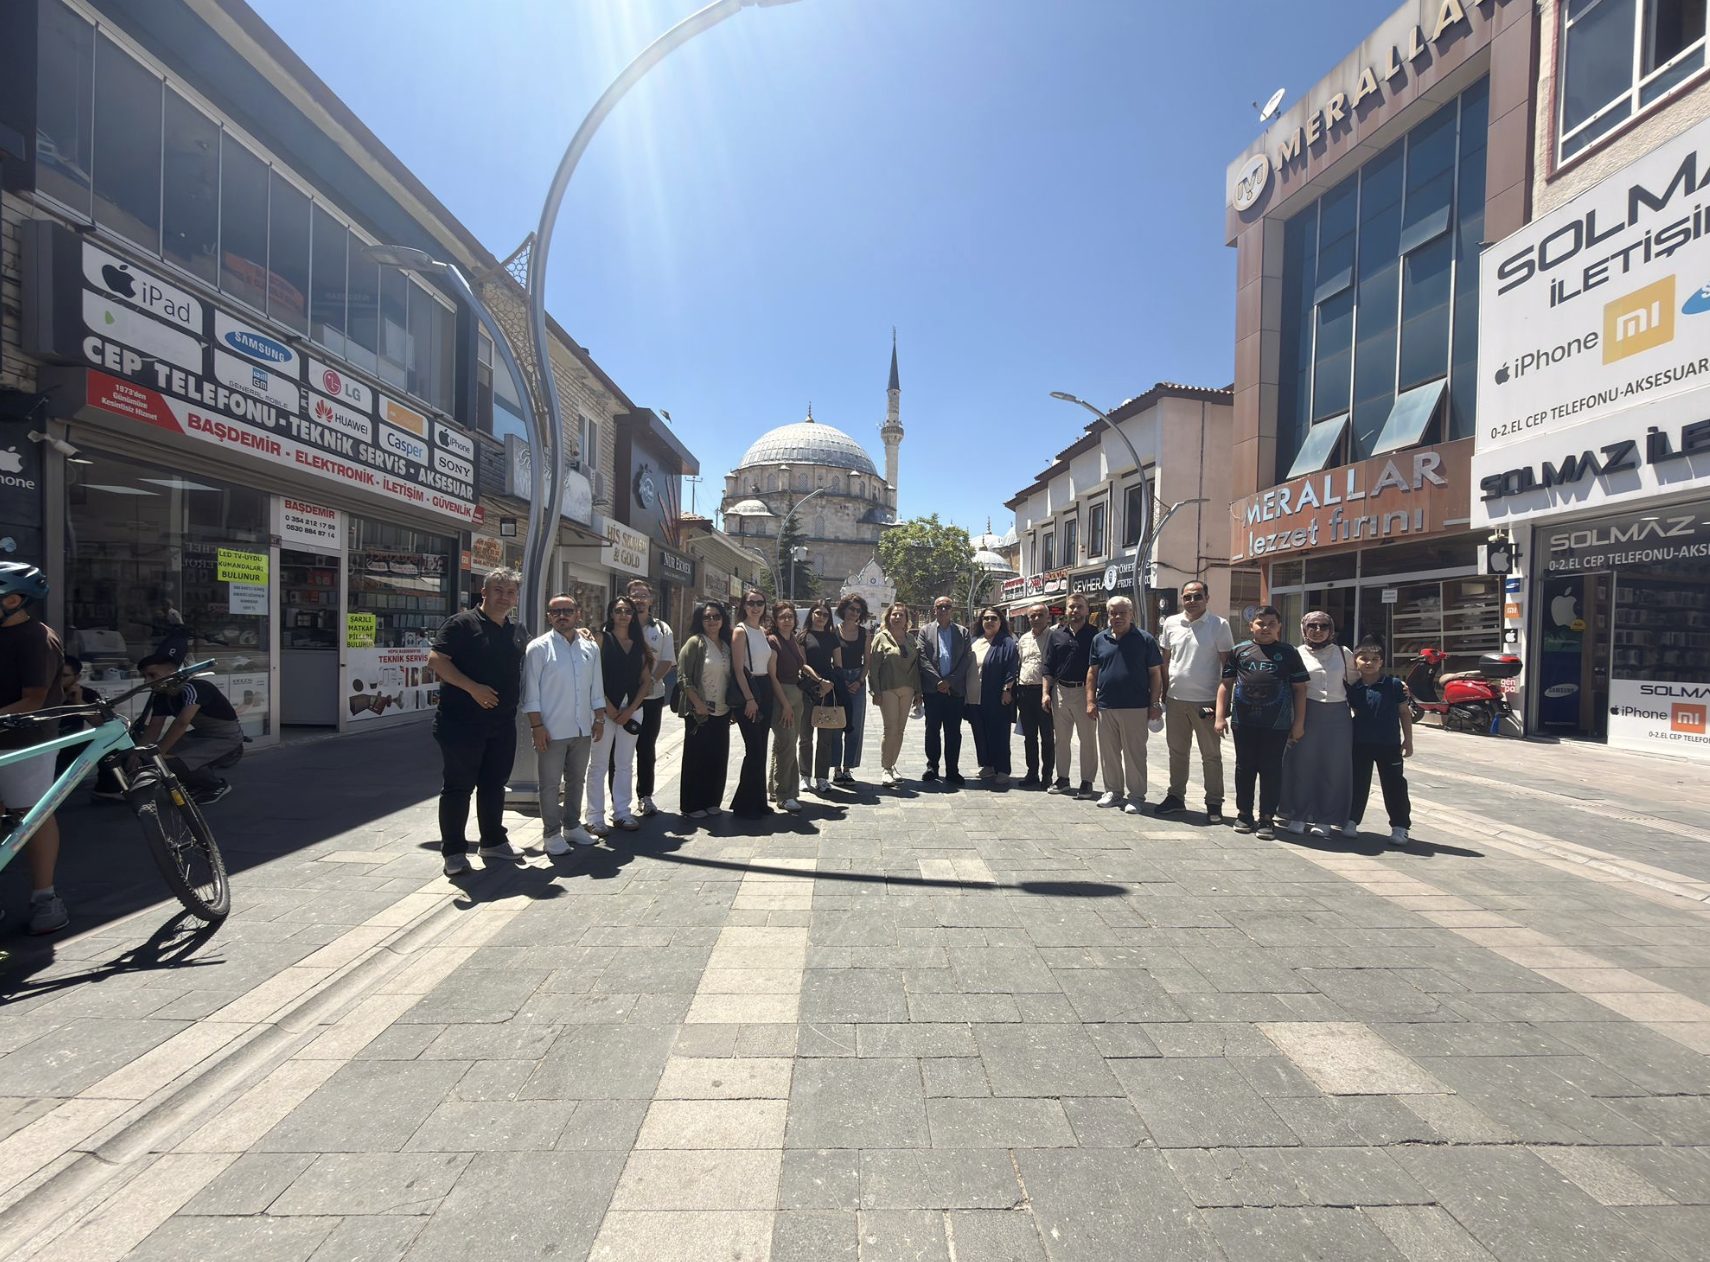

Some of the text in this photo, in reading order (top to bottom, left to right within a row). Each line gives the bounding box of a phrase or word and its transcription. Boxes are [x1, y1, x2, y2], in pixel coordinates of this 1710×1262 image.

[1277, 0, 1485, 173] MERALLA
[1497, 150, 1710, 297] SOLM
[1550, 203, 1710, 308] İLETİŞİ
[142, 282, 190, 324] iPad
[234, 331, 285, 363] SAMSUNG
[1514, 331, 1599, 379] iPhone
[229, 380, 264, 399] GENERAL
[345, 383, 361, 402] LG
[83, 336, 142, 375] CEP
[418, 467, 473, 500] AKSESUAR
[335, 413, 368, 436] HUAWEI
[1490, 420, 1523, 439] 0-2.EL
[1525, 411, 1547, 429] CEP
[387, 432, 423, 458] Casper
[449, 436, 471, 454] iPhone
[188, 412, 281, 457] BAŞDEMİR
[295, 449, 375, 486] ELEKTRONİK
[383, 475, 424, 503] İLETİŞİM
[432, 495, 471, 518] GÜVENLİK
[438, 456, 471, 477] SONY
[1481, 439, 1636, 502] SOLMAZ
[1244, 451, 1447, 527] MERALLAR
[284, 499, 335, 519] BAŞDEMİR
[305, 519, 317, 527] 212
[1249, 507, 1423, 557] lezzet fırını
[1550, 515, 1696, 551] SOLMAZ
[219, 550, 232, 558] LED
[621, 549, 640, 569] GOLD
[1549, 543, 1710, 571] 0-2.EL CEP TELEFONU-AKS
[222, 570, 260, 582] BULUNUR
[1621, 706, 1668, 721] iPhone
[1684, 735, 1710, 744] TELEFO
